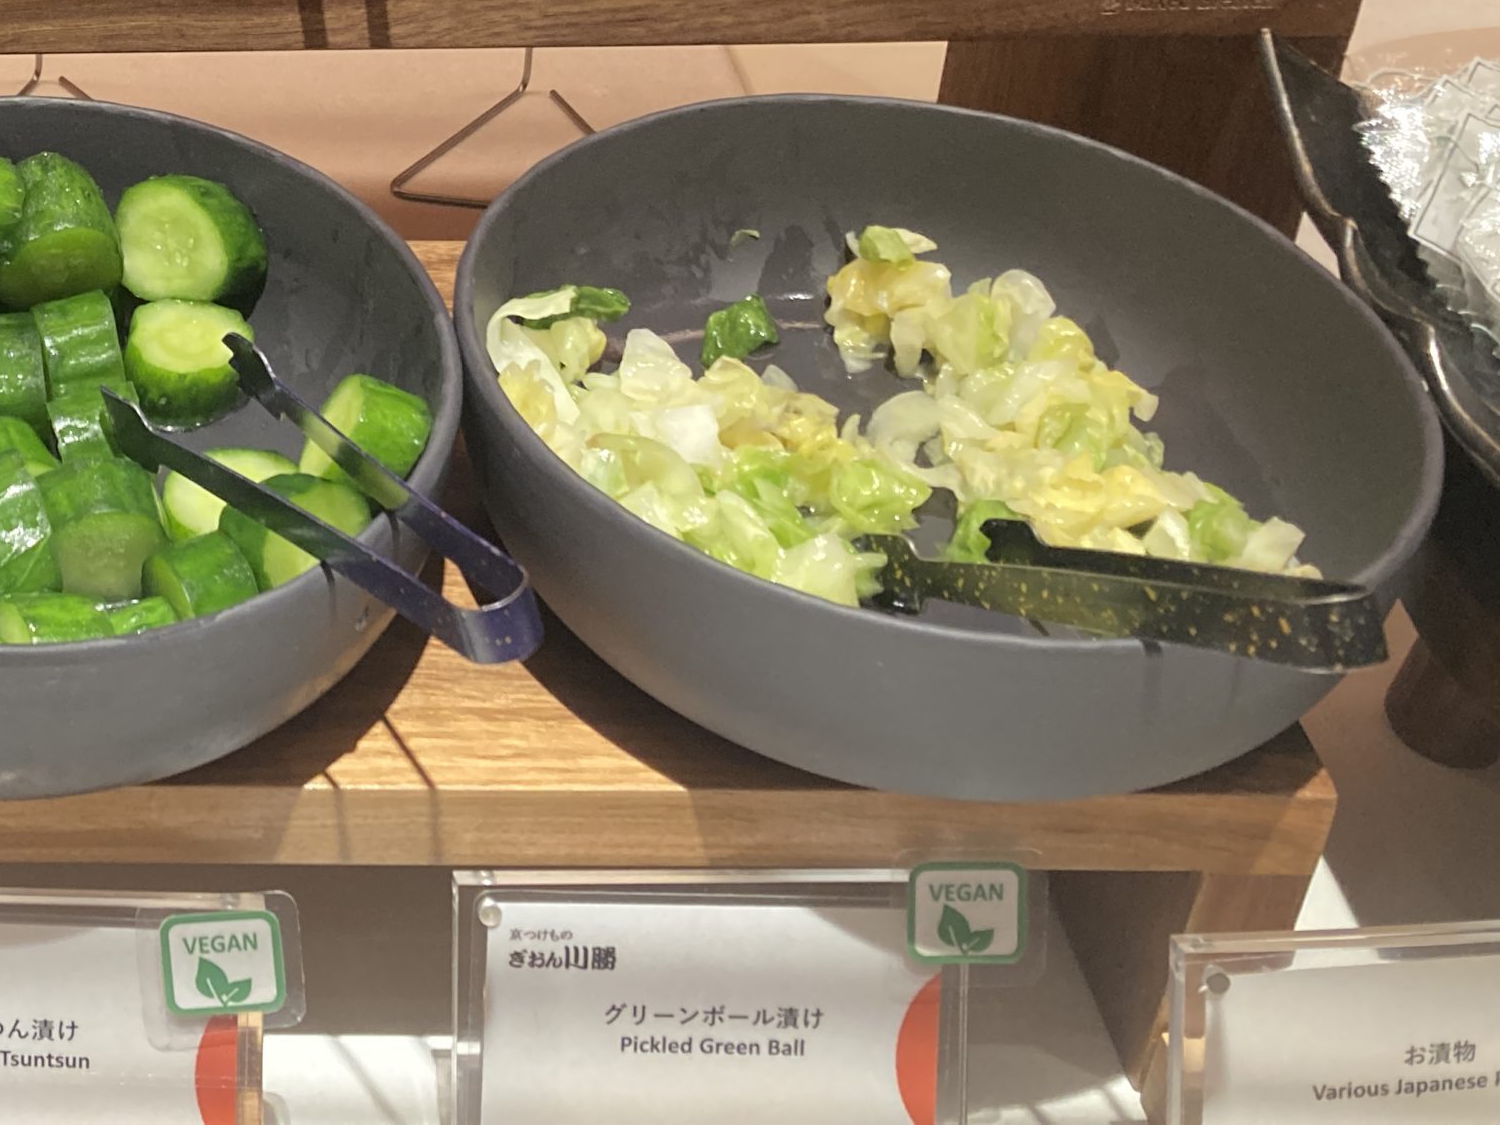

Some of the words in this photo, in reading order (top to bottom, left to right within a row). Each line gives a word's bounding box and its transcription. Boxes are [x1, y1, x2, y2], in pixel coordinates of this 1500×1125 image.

[928, 882, 1004, 903] VEGAN
[182, 932, 258, 955] VEGAN
[508, 945, 617, 971] ぎおん川勝
[605, 1002, 825, 1030] グリーンボール漬け
[620, 1035, 693, 1054] Pickled
[699, 1037, 761, 1056] Green
[767, 1038, 805, 1057] Ball
[1403, 1039, 1477, 1066] お漬物
[0, 1050, 90, 1070] Tsuntsun
[1312, 1081, 1390, 1101] Various
[1394, 1075, 1488, 1099] Japanese
